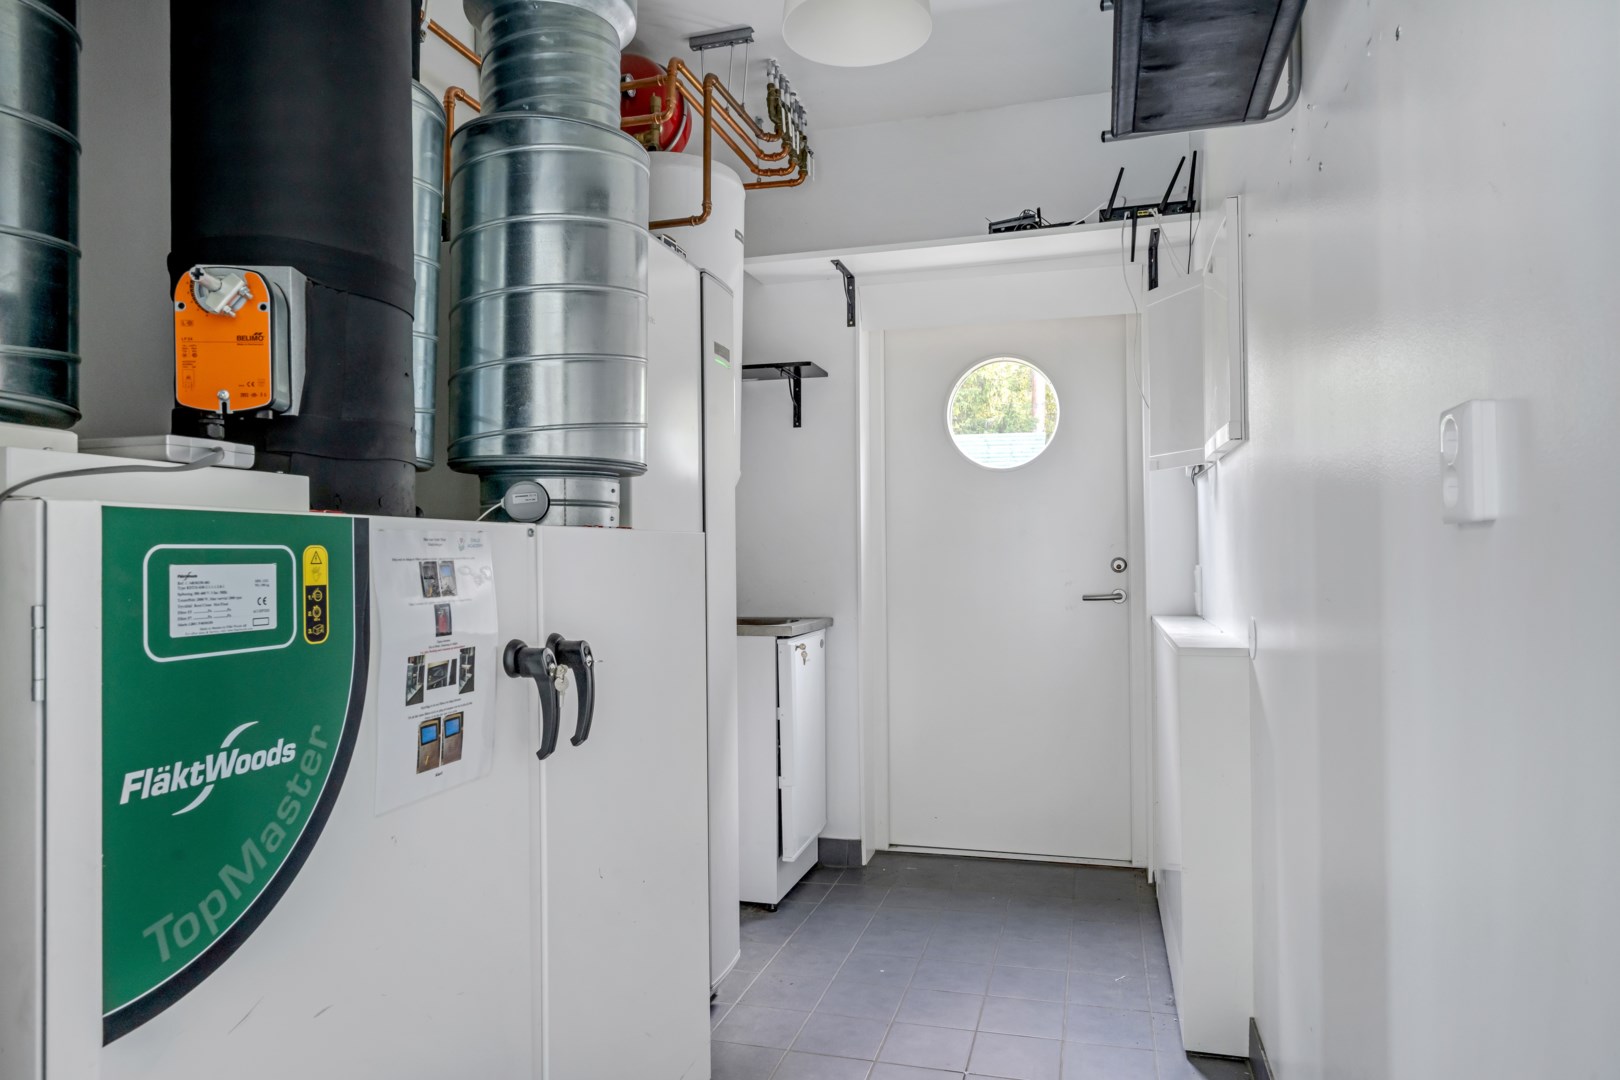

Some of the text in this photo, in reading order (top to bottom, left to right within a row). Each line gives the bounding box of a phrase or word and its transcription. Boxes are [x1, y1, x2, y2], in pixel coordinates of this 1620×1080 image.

[257, 596, 267, 606] CE
[119, 738, 297, 805] FläktWoods
[142, 724, 329, 962] TopMaster
